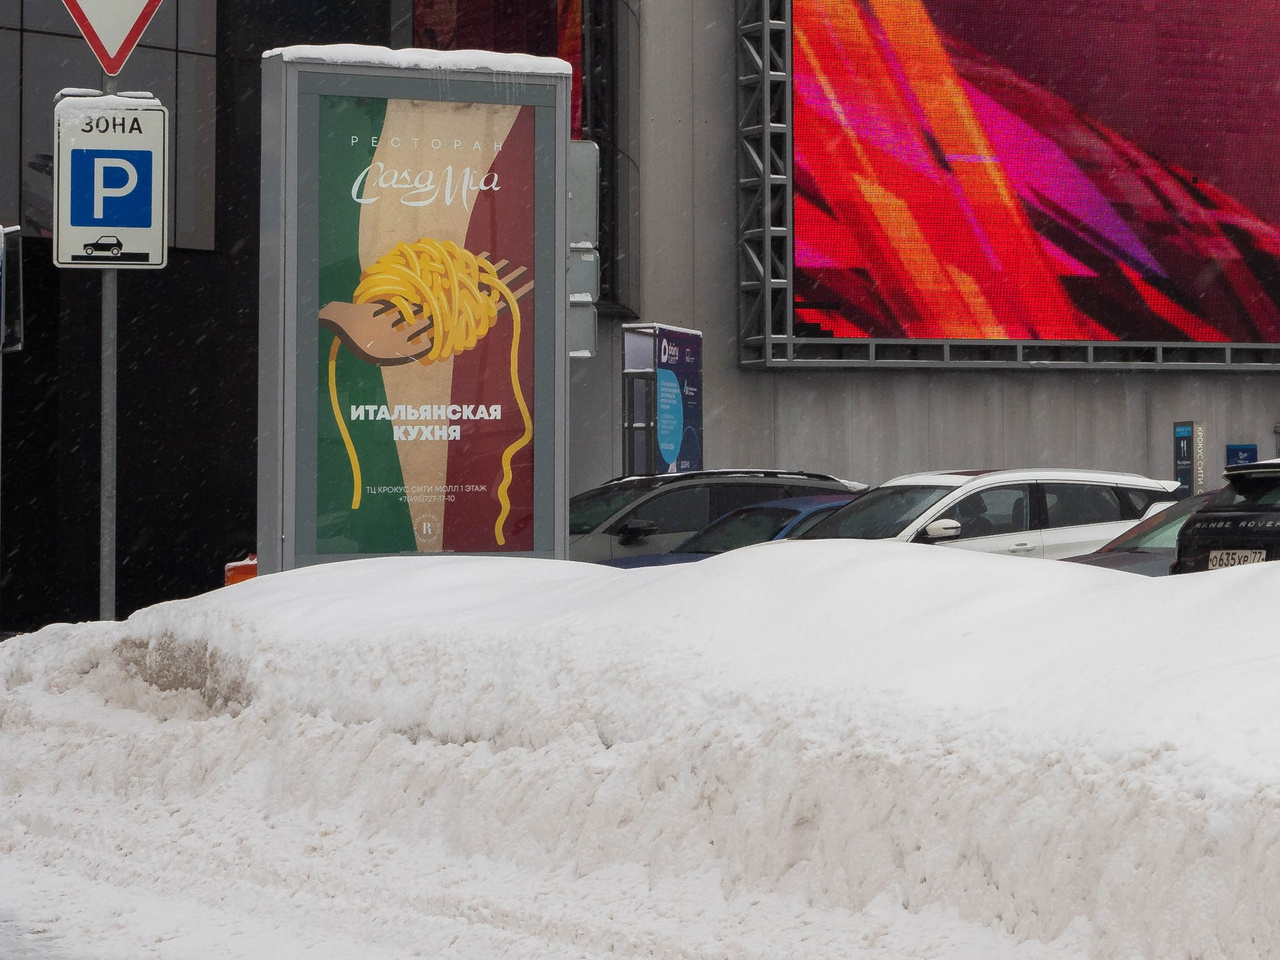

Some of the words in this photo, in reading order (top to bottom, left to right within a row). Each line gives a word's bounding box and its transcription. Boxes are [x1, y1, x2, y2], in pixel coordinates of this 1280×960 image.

[81, 115, 143, 134] ЗОНА
[351, 136, 502, 151] РЕСТОРАН
[351, 161, 437, 207] Casa
[435, 164, 501, 213] Mia
[350, 404, 502, 421] ИТАЛЬЯНСКАЯ
[393, 425, 461, 441] КУХНЯ
[1196, 426, 1204, 460] КРОКУС
[1196, 460, 1204, 485] СИТИ
[366, 486, 377, 494] ТЦ
[378, 486, 409, 494] КРОКУС
[411, 485, 433, 493] СИТИ
[435, 485, 459, 493] МОЛЛ
[465, 484, 487, 492] ЭТАЖ
[1194, 521, 1232, 529] RANGE
